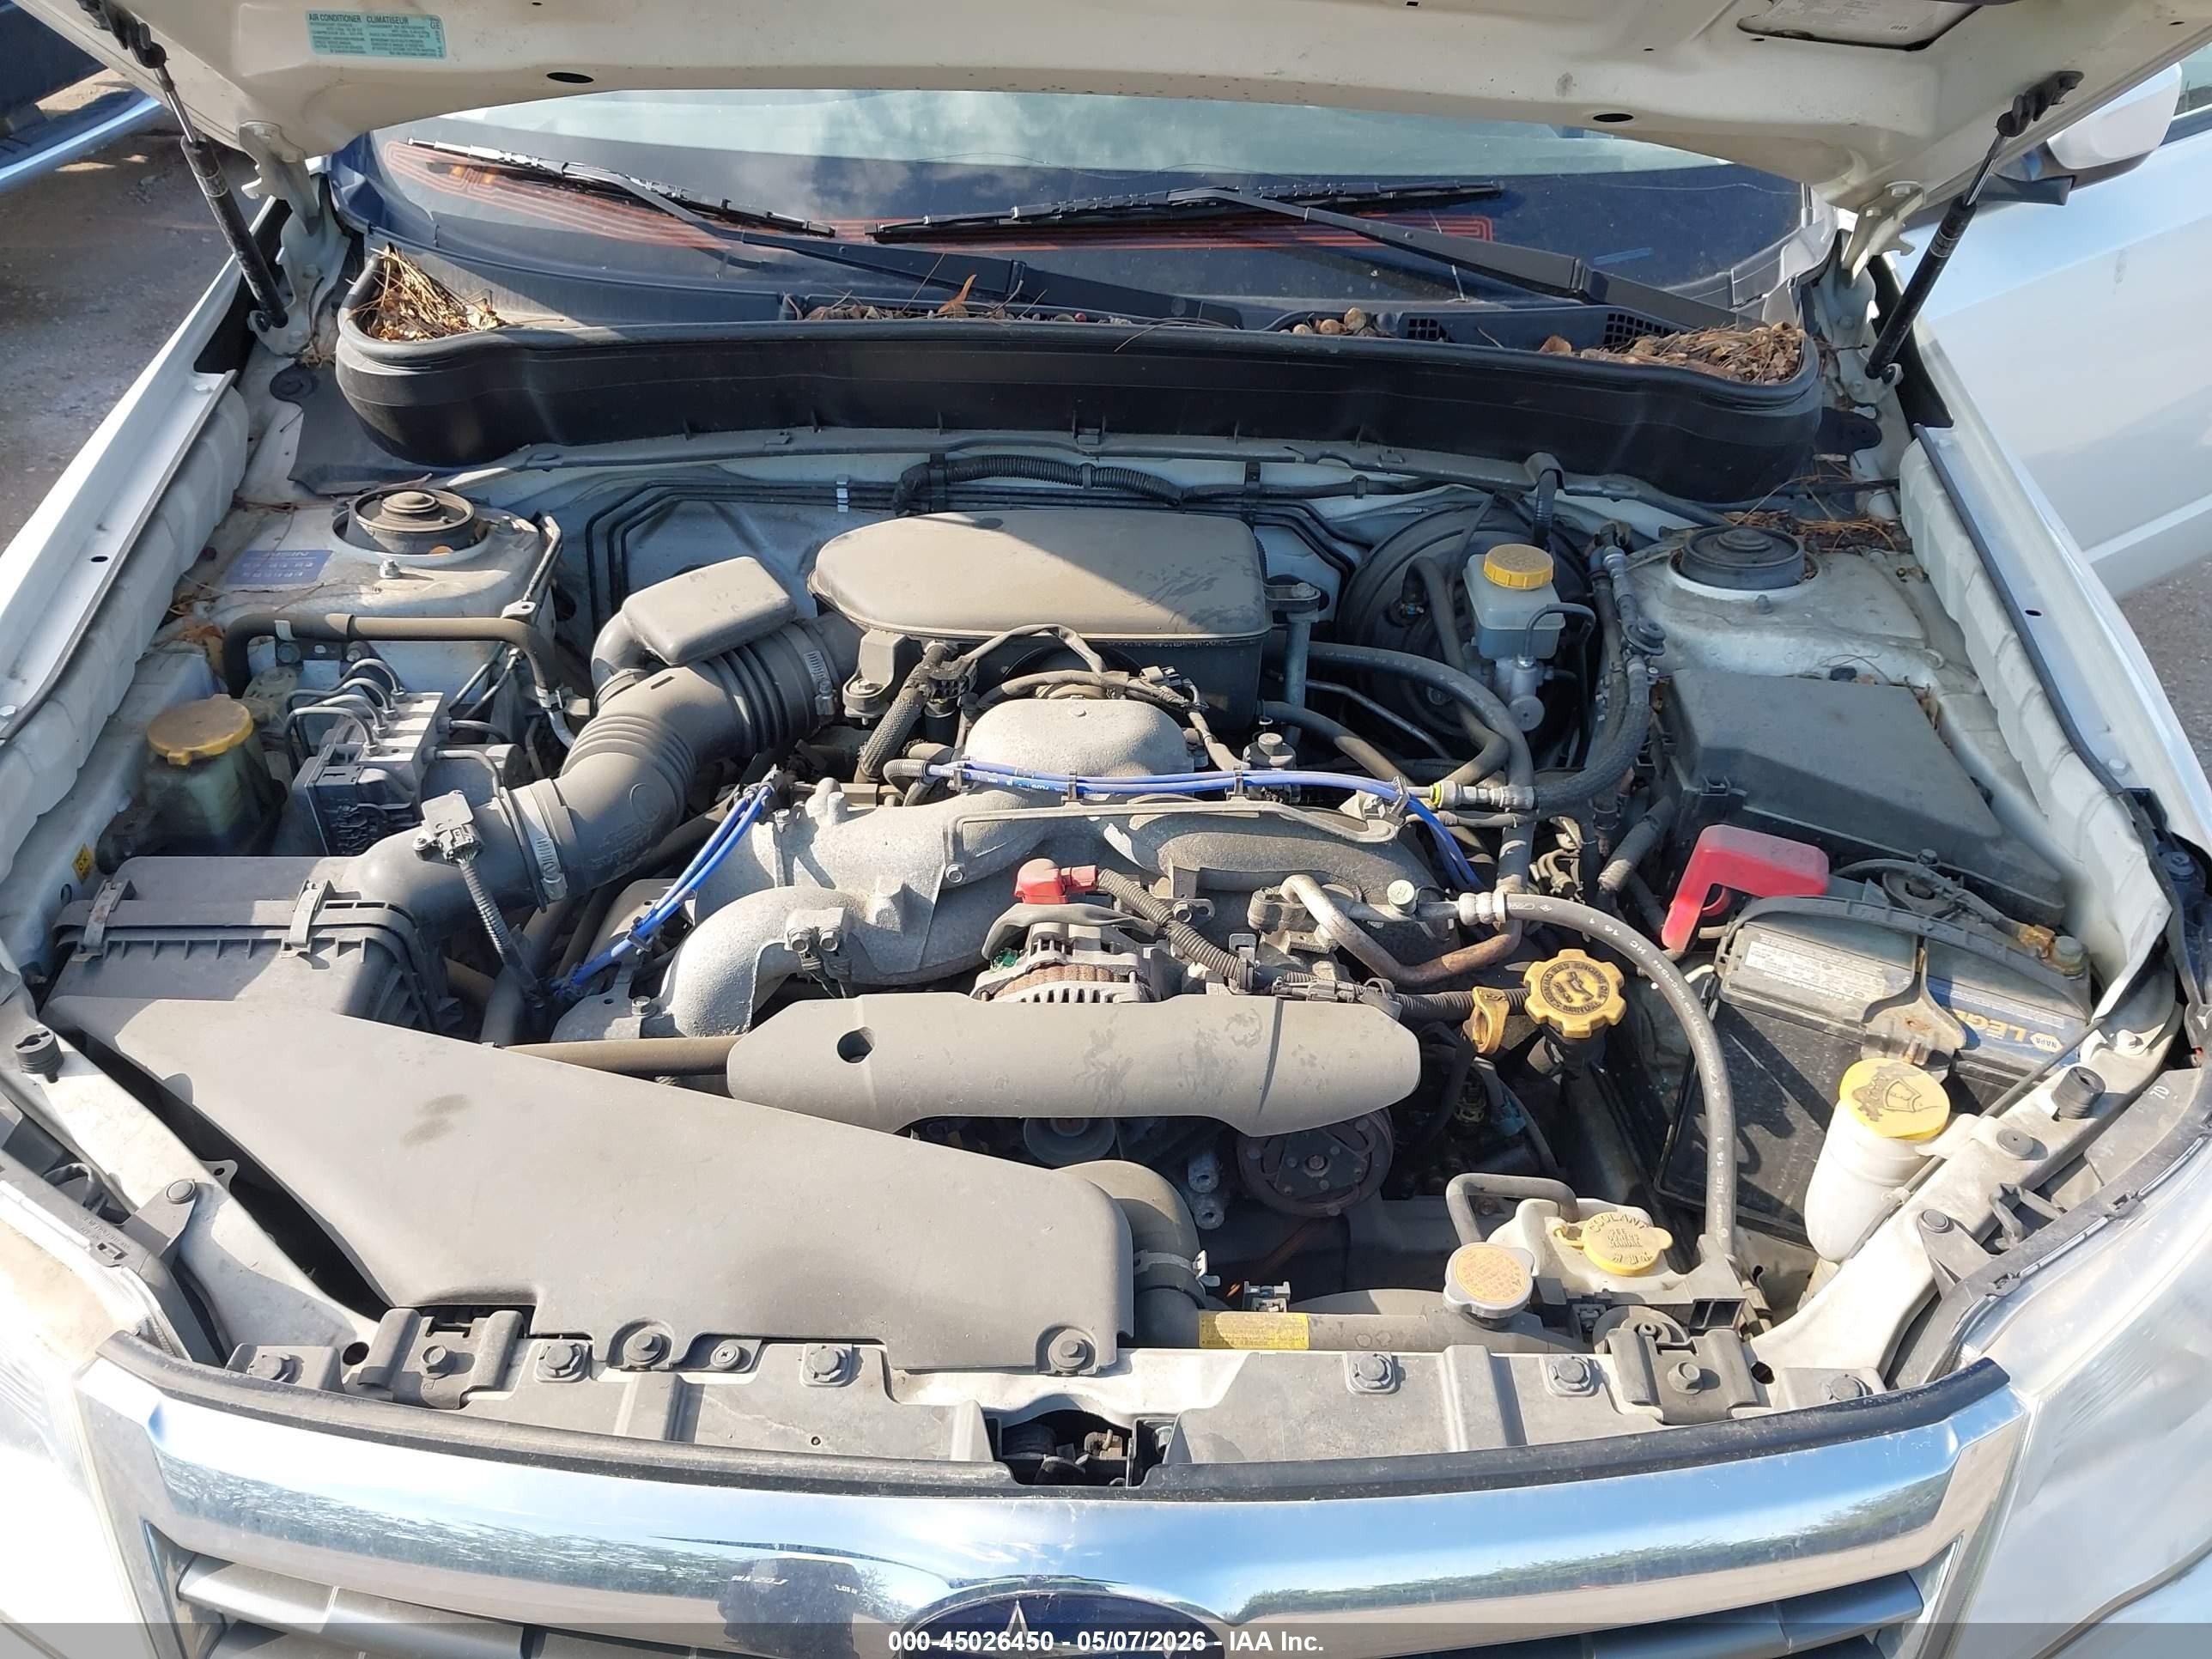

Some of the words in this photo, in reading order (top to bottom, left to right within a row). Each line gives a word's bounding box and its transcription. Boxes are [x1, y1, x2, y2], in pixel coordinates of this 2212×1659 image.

[309, 13, 319, 21] AIR
[319, 14, 362, 23] CONDITIONER
[366, 15, 409, 25] CLIMATISEUR
[2034, 1036, 2057, 1048] NAPA
[1589, 1214, 1648, 1233] COOLANT
